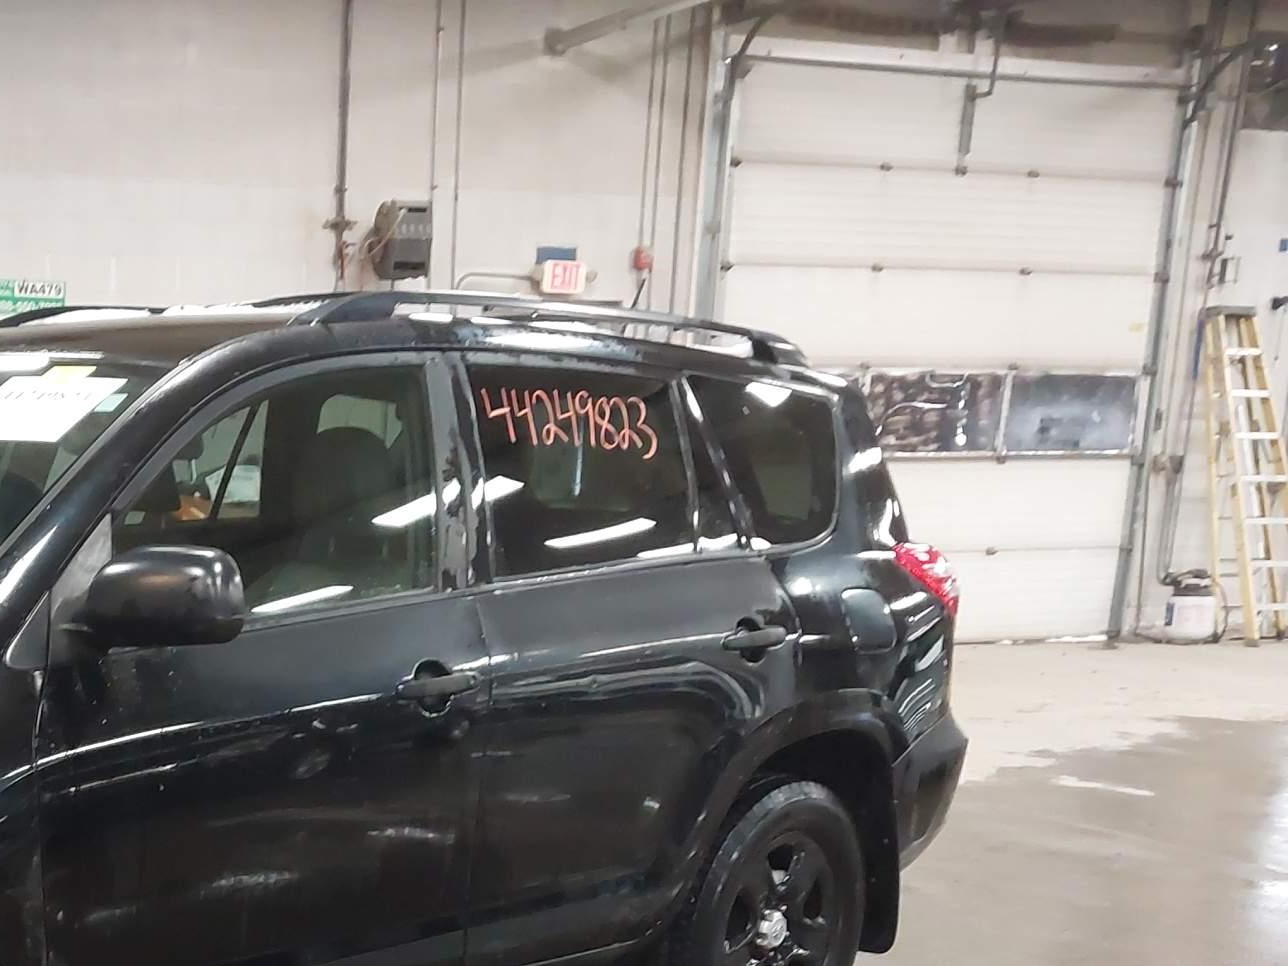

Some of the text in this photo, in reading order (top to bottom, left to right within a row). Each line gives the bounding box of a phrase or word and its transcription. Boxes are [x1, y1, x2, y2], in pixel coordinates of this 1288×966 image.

[16, 280, 63, 297] WA479
[550, 262, 581, 290] EXIT
[480, 387, 658, 460] 44249823
